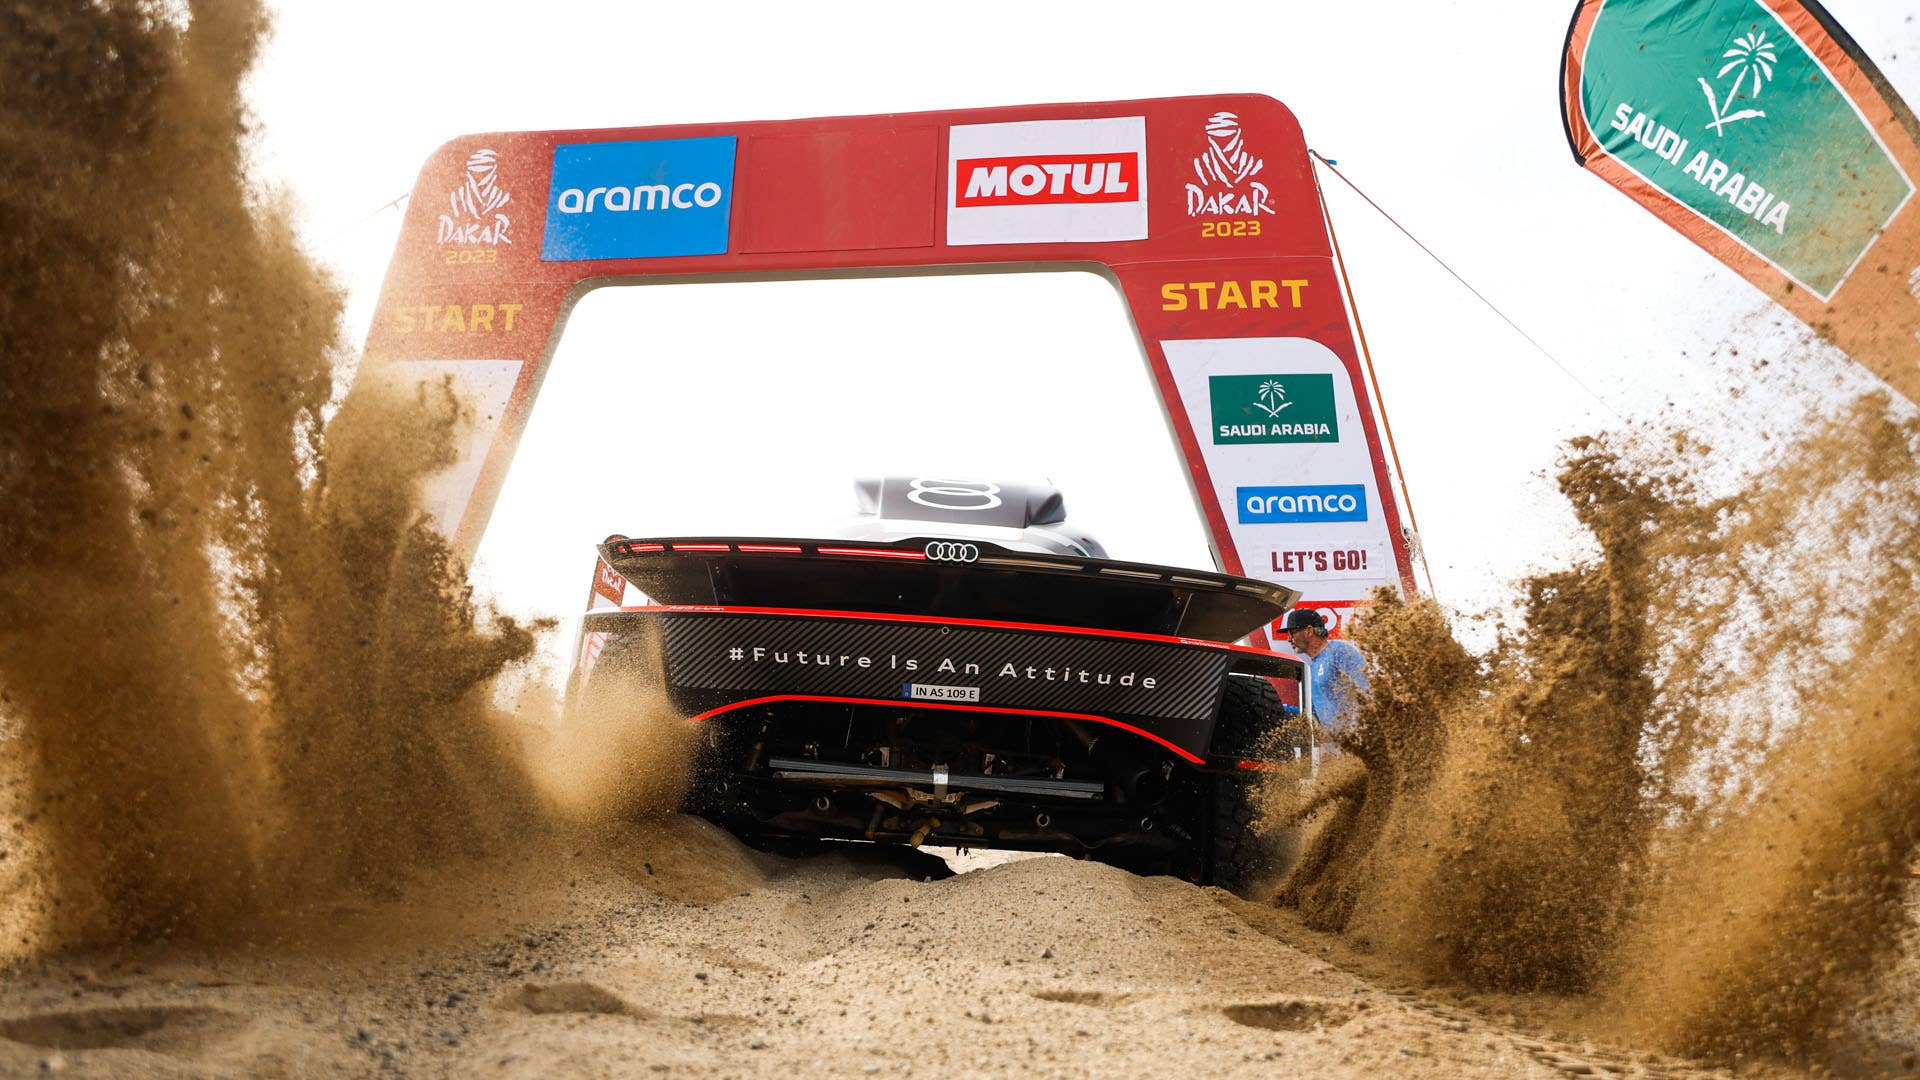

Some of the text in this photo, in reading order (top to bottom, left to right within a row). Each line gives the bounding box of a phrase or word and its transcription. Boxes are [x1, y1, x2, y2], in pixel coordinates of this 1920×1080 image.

[965, 162, 1129, 198] MOTUL
[1611, 103, 1790, 234] SAUDI ARABIA
[558, 182, 721, 213] aramco
[1185, 183, 1275, 216] DAKAR
[437, 213, 512, 245] DAKAR
[1201, 220, 1261, 237] 2023
[445, 249, 497, 264] 2023
[1161, 279, 1309, 311] START
[392, 303, 523, 332] START
[1220, 423, 1330, 436] SAUDI ARABIA
[1246, 494, 1357, 514] aramco
[1333, 550, 1368, 571] GO!
[729, 647, 1156, 689] #Future Is An Attitude
[915, 687, 927, 696] IN
[929, 688, 944, 697] AS
[947, 689, 966, 698] 109
[969, 690, 976, 699] E
